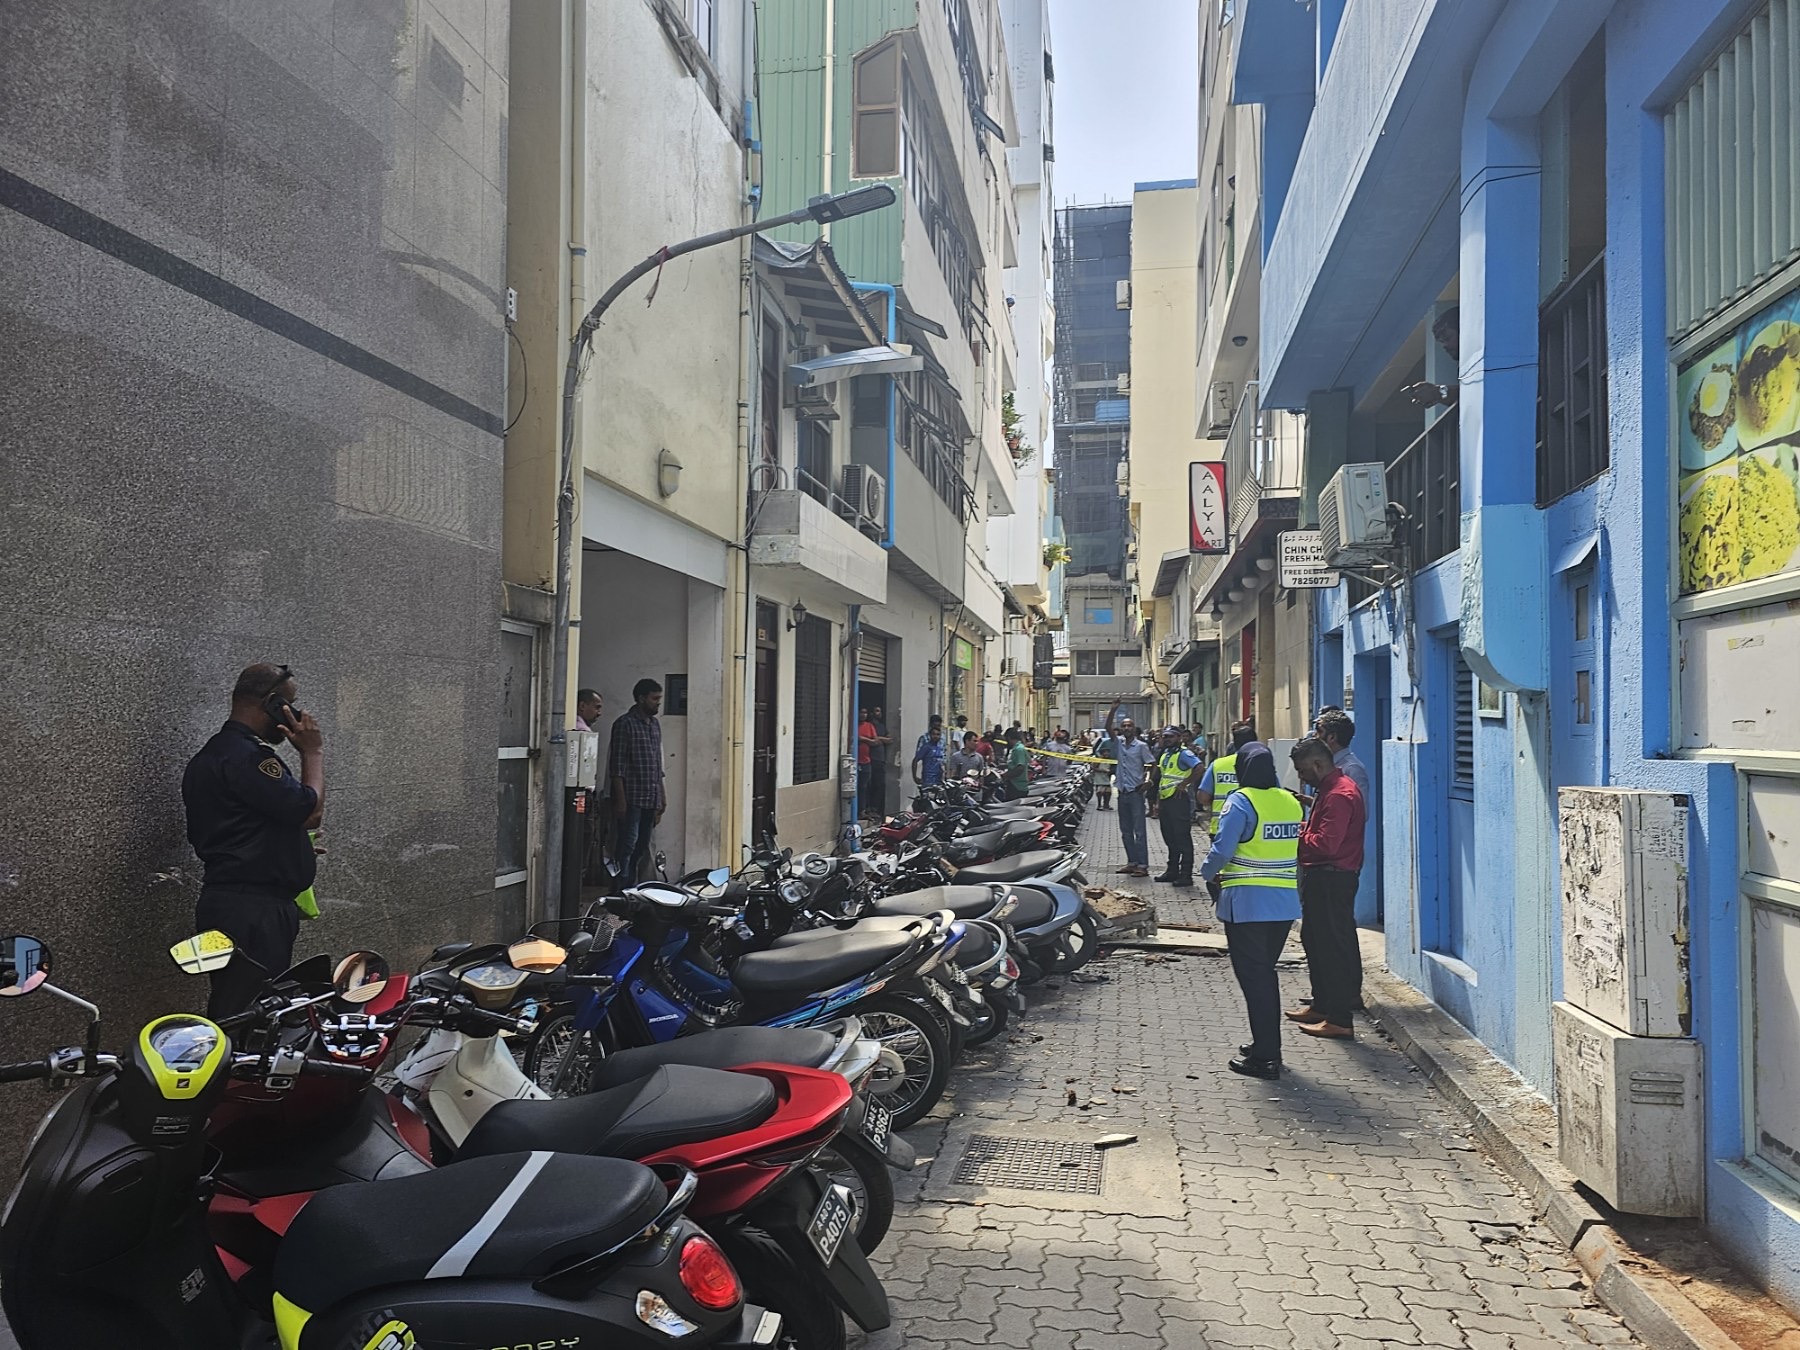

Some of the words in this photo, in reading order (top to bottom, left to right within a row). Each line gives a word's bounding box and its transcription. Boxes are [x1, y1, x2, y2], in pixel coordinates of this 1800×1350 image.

[1202, 471, 1215, 536] AALYA
[1196, 539, 1223, 548] MART
[1284, 545, 1308, 554] CHIN
[1310, 545, 1323, 554] CH
[1284, 555, 1311, 563] FRESH
[1292, 576, 1330, 585] 7825077
[1217, 774, 1238, 783] POL
[873, 1107, 889, 1148] P3862
[819, 1204, 847, 1256] P4075
